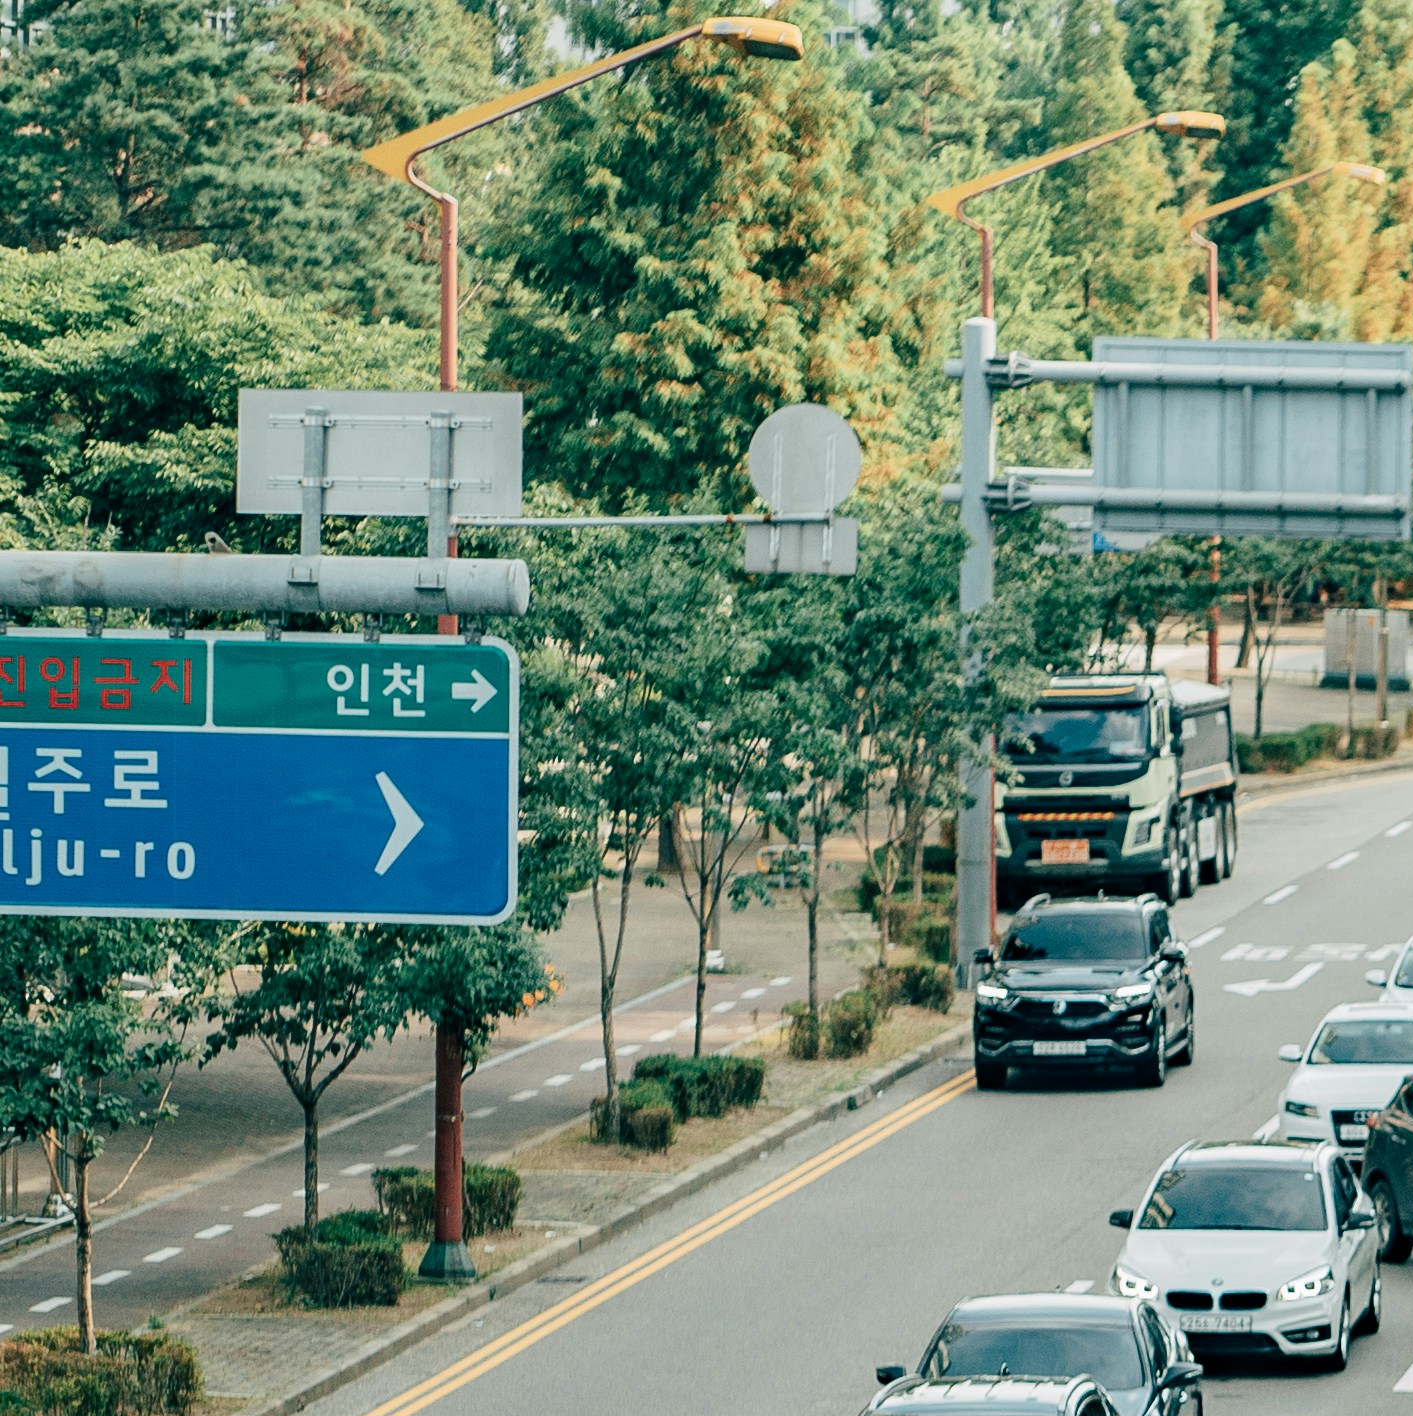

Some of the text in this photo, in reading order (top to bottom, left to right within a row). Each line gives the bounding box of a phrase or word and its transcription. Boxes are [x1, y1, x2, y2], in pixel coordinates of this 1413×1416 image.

[0, 655, 192, 710] 진입금지
[326, 662, 428, 718] 인천
[2, 828, 196, 886] lju-ro
